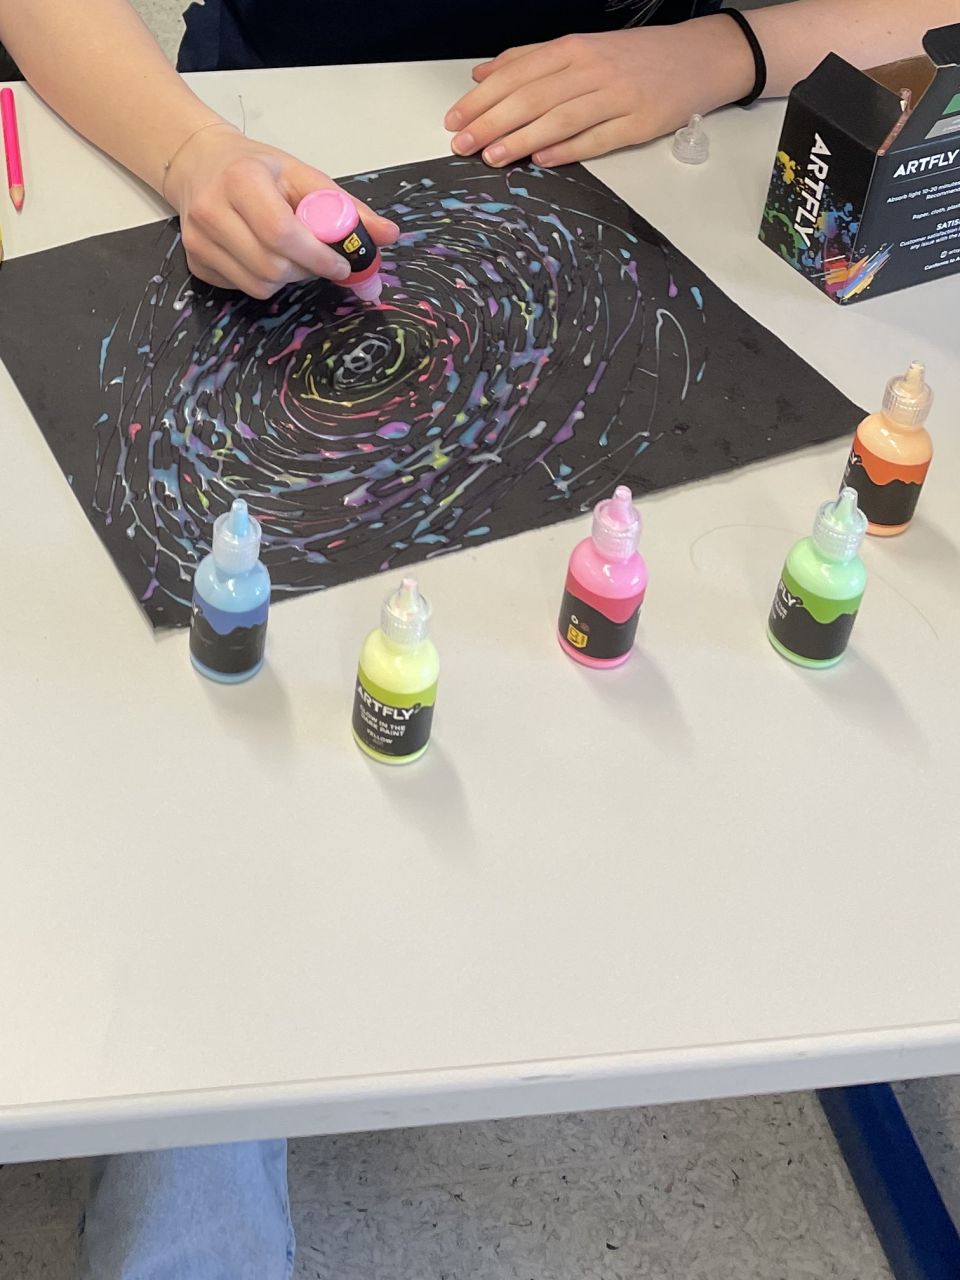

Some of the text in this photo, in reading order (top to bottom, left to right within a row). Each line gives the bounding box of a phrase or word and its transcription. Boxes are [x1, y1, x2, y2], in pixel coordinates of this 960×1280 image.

[892, 149, 960, 178] ARTFLY
[793, 132, 832, 248] ARTFLY
[936, 218, 960, 231] SATIS
[357, 685, 415, 721] ARTFLY
[367, 728, 392, 744] YELLOW
